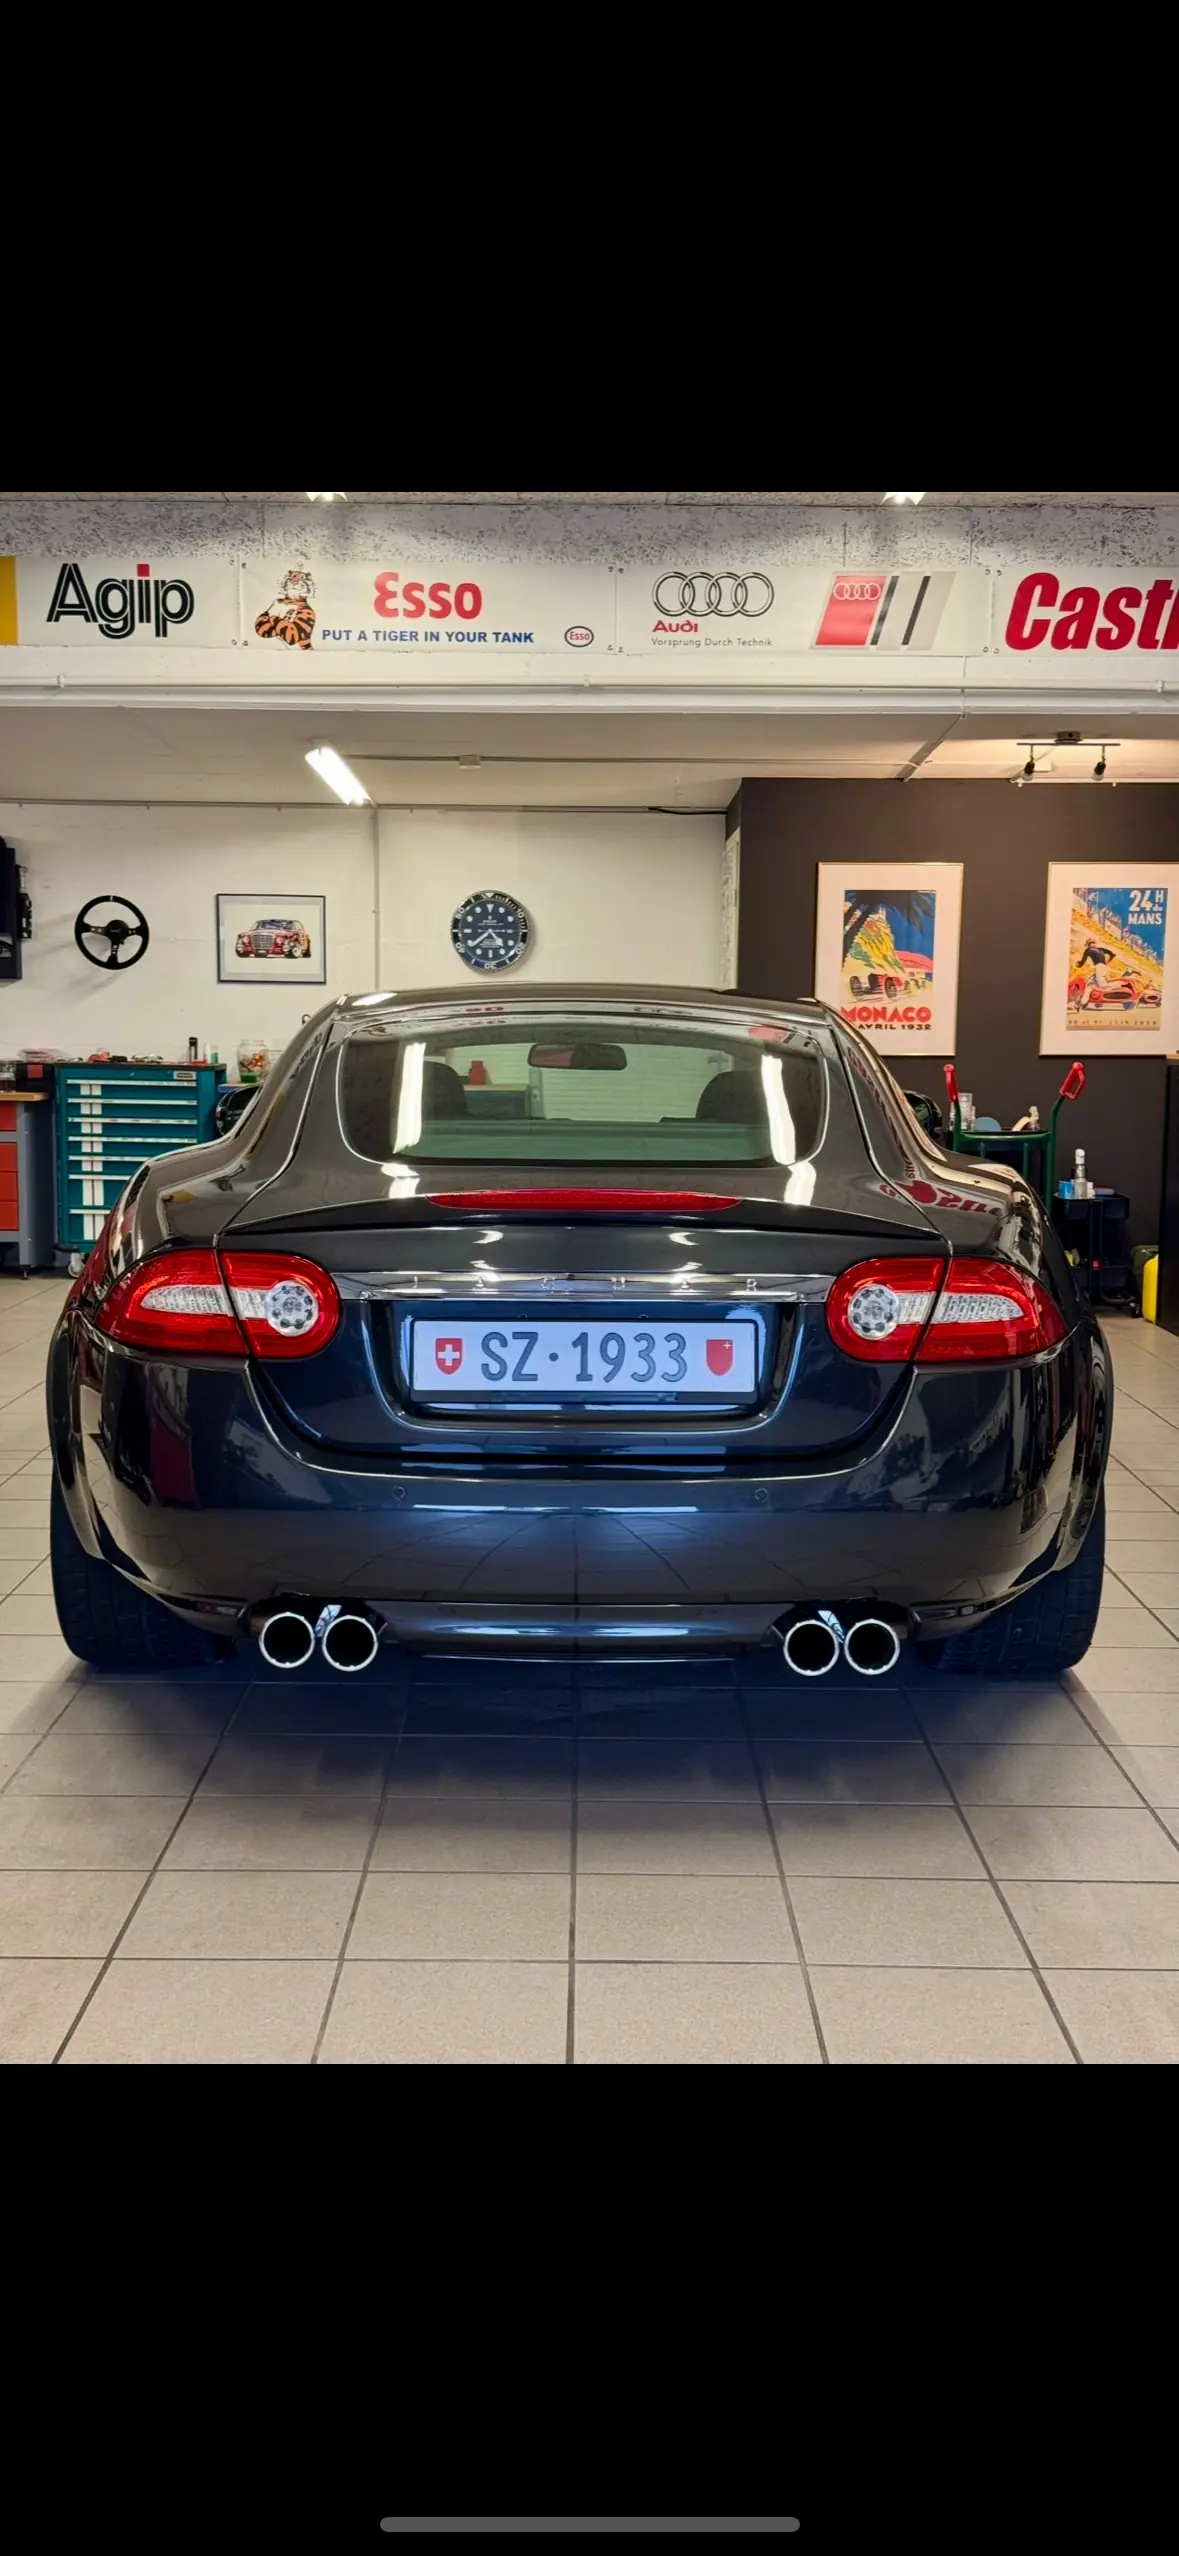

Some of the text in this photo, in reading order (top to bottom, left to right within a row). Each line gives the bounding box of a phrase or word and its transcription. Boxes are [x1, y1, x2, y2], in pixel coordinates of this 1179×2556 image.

[46, 563, 195, 639] Agip
[373, 571, 482, 620] Esso
[652, 619, 699, 633] Audi
[322, 629, 534, 643] PUT A TIGER IN YOUR TANK
[568, 630, 591, 642] Esso
[651, 638, 773, 648] Vorsprung Durch Technik
[1128, 912, 1163, 925] MANS
[840, 1006, 932, 1022] MONACO
